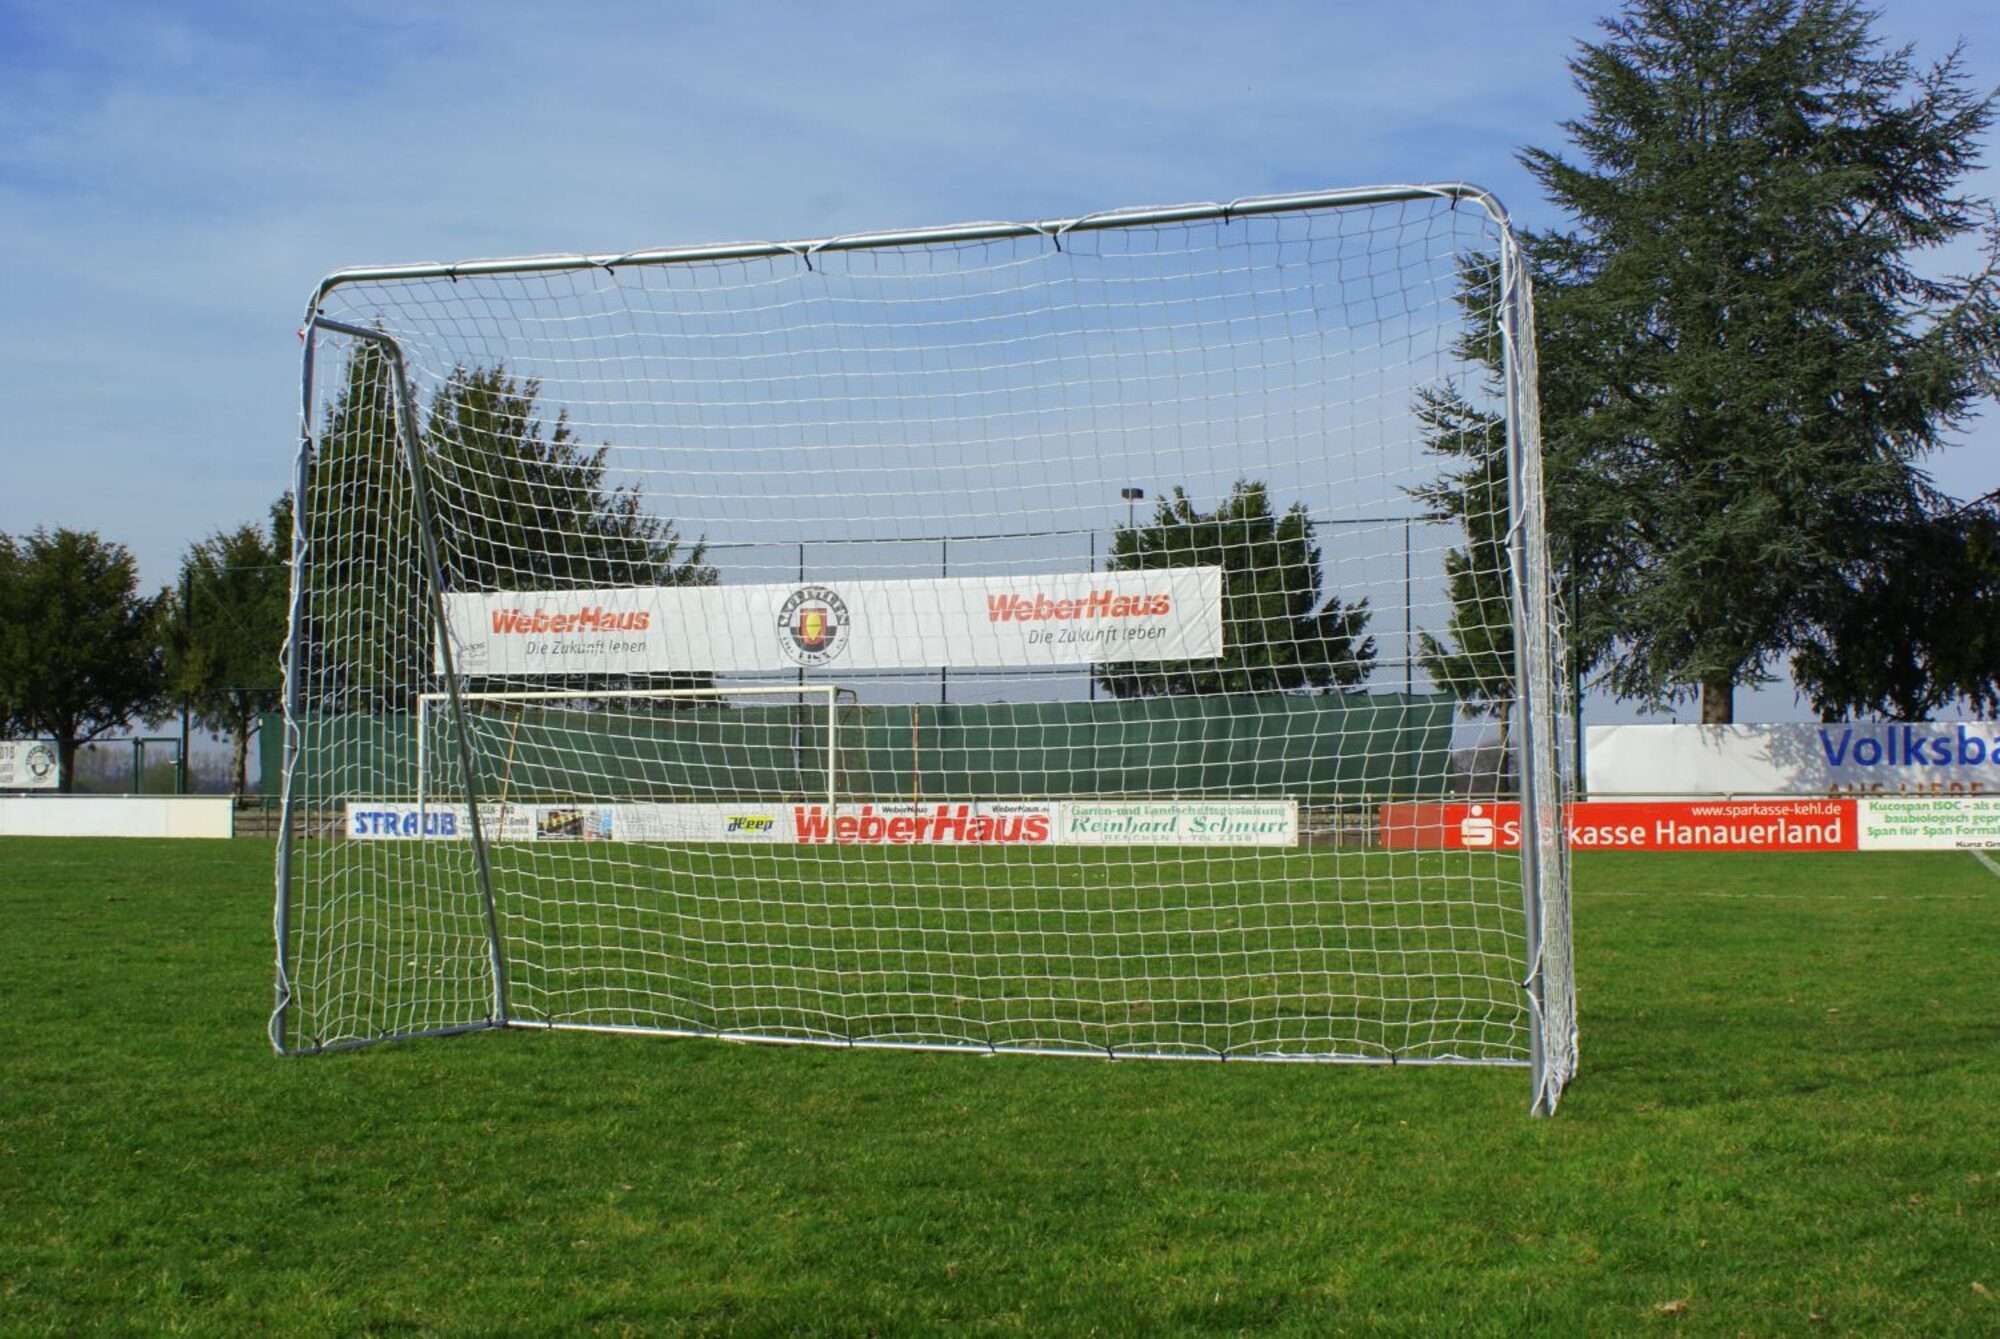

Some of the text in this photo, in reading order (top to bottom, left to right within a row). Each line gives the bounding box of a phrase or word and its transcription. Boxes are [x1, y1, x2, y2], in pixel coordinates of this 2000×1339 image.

[986, 589, 1170, 622] WeberHaus
[492, 604, 650, 634] WeberHaus
[1028, 625, 1166, 646] Die Zukunft leben
[526, 639, 647, 656] Die Zukunft leben
[1691, 803, 1841, 817] www.sparkasse-kehl.de
[1869, 801, 1931, 814] Kucospan
[355, 811, 458, 836] STRAUB
[794, 804, 1049, 844] WeberHaus
[1070, 815, 1288, 833] Reinhard Schnurr
[1884, 814, 1969, 825] baubiologisch
[1656, 818, 1841, 845] Hanauerland
[1867, 826, 1897, 838] Span
[1922, 826, 1952, 838] Span
